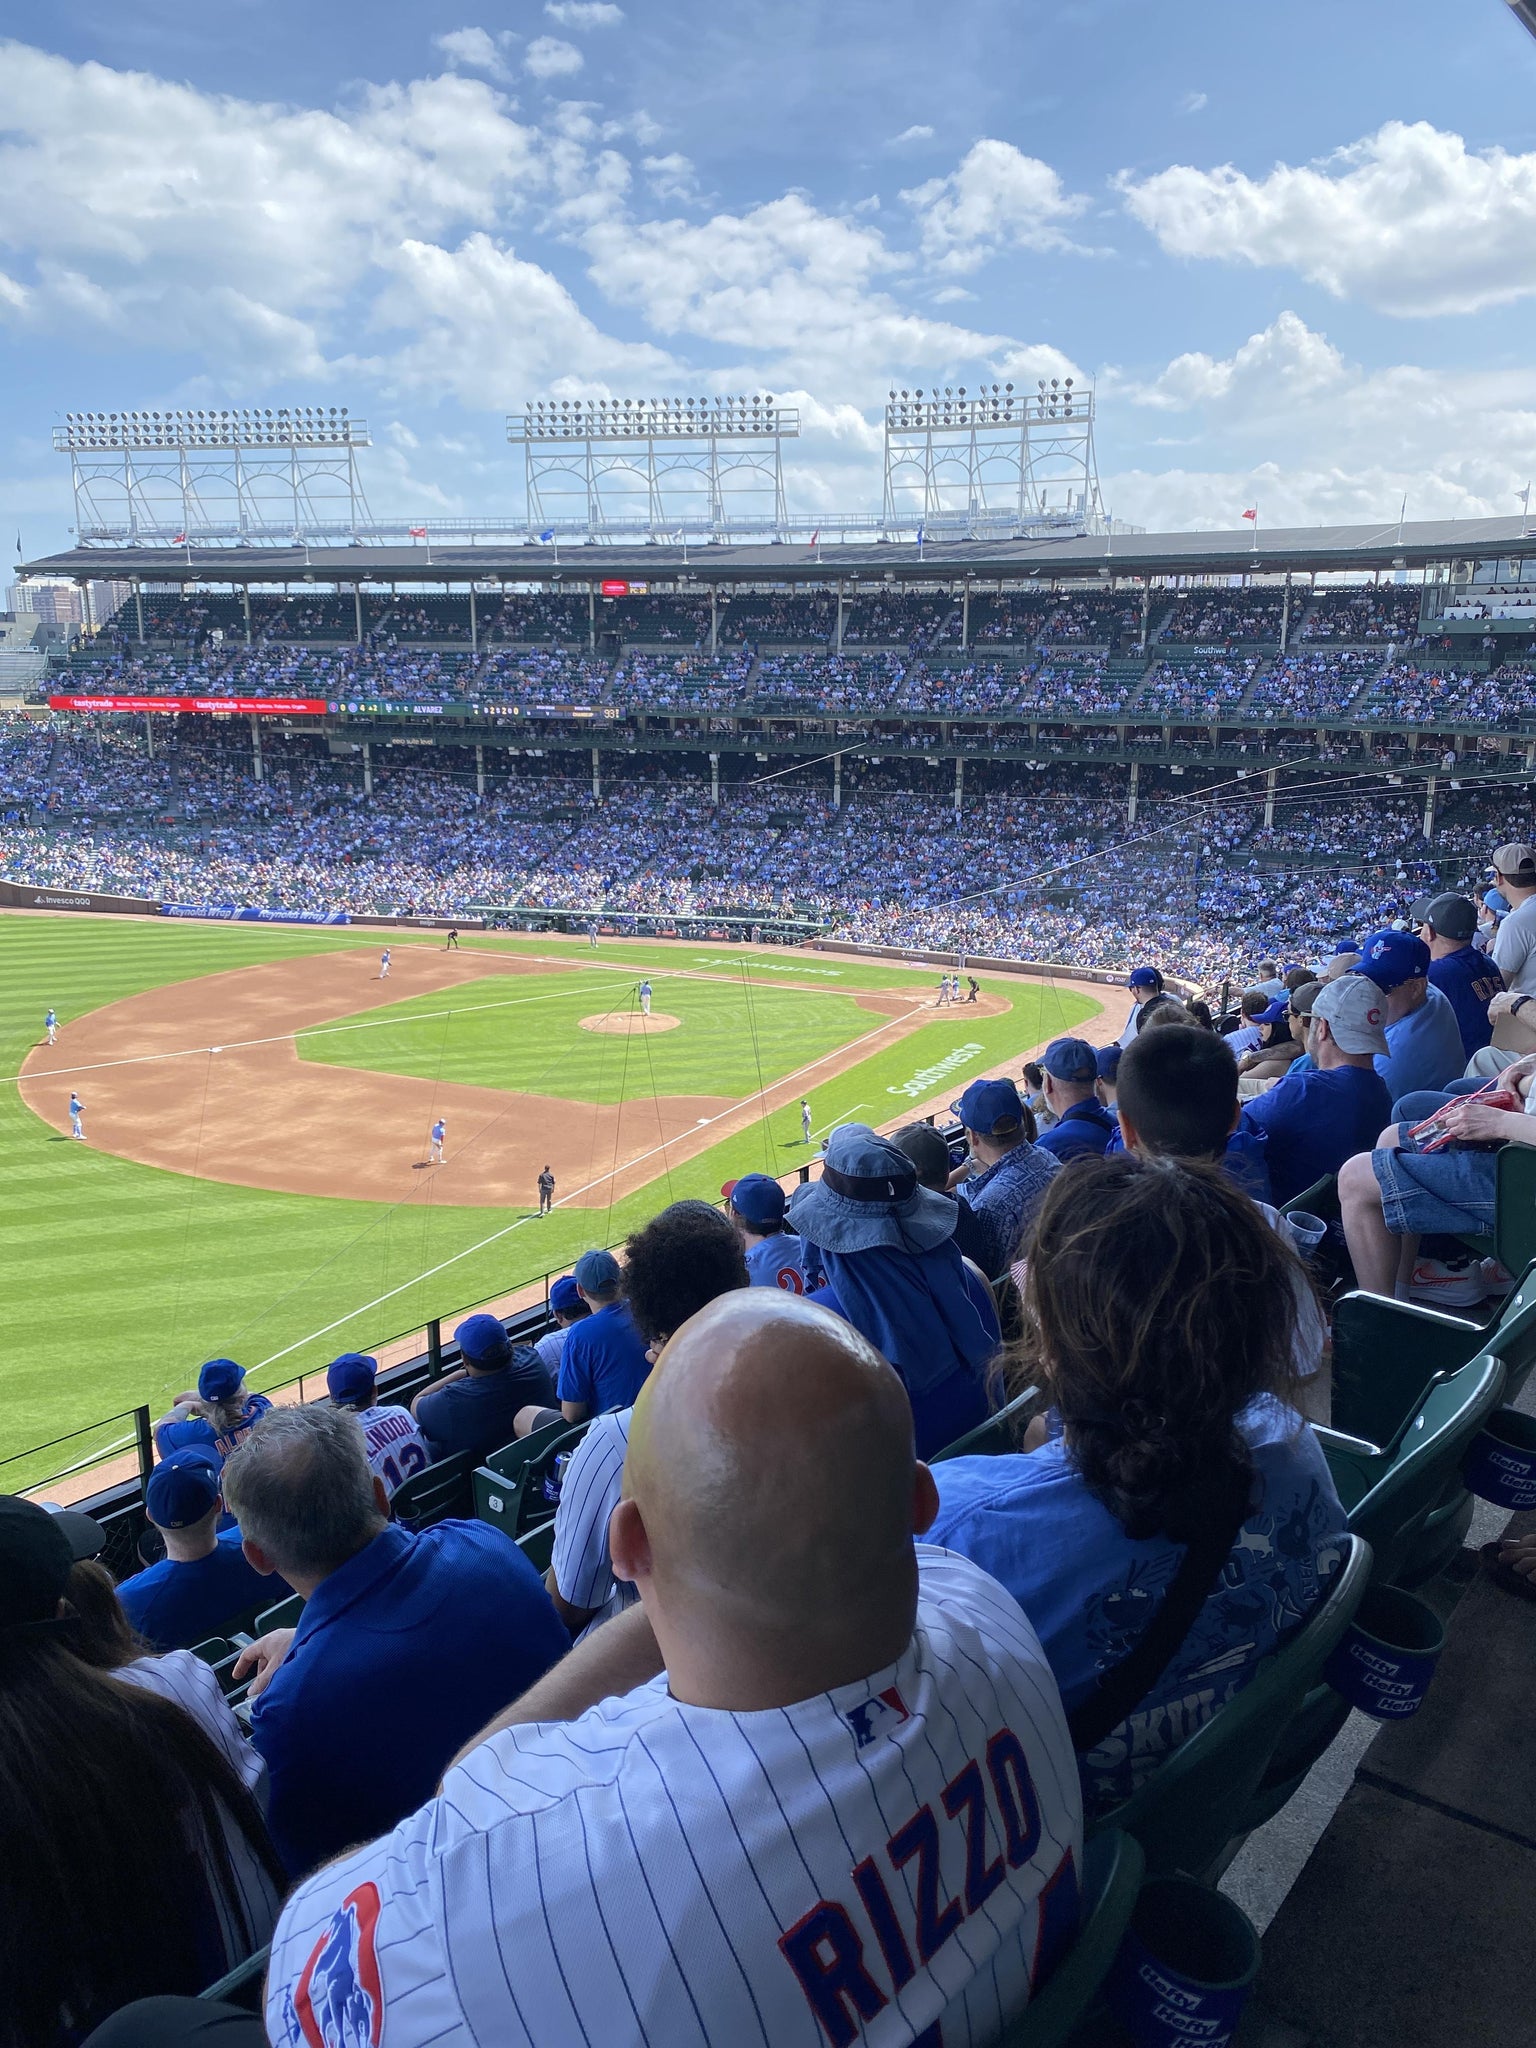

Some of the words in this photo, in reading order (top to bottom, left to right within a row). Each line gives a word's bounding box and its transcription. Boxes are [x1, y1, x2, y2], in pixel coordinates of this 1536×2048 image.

[74, 699, 114, 708] tastytrade
[196, 701, 239, 710] tastytrade
[413, 705, 443, 714] ALVAREZ
[604, 709, 615, 719] 93
[46, 896, 74, 905] Invesco
[75, 897, 91, 906] QQQ
[168, 906, 208, 918] Reynolds
[208, 907, 232, 918] Wrap
[258, 909, 300, 920] Reynolds
[300, 911, 326, 922] Wrap
[1367, 1008, 1381, 1025] C
[886, 1048, 981, 1097] Southwest
[1488, 1452, 1531, 1475] Hefty
[1351, 1644, 1400, 1676] Hefty
[1363, 1673, 1414, 1696] Hefty
[1377, 1697, 1421, 1712] Hefty
[777, 1728, 1042, 2048] RIZZO
[1139, 1965, 1203, 2011] Hefty
[1154, 2004, 1222, 2036] Hefty
